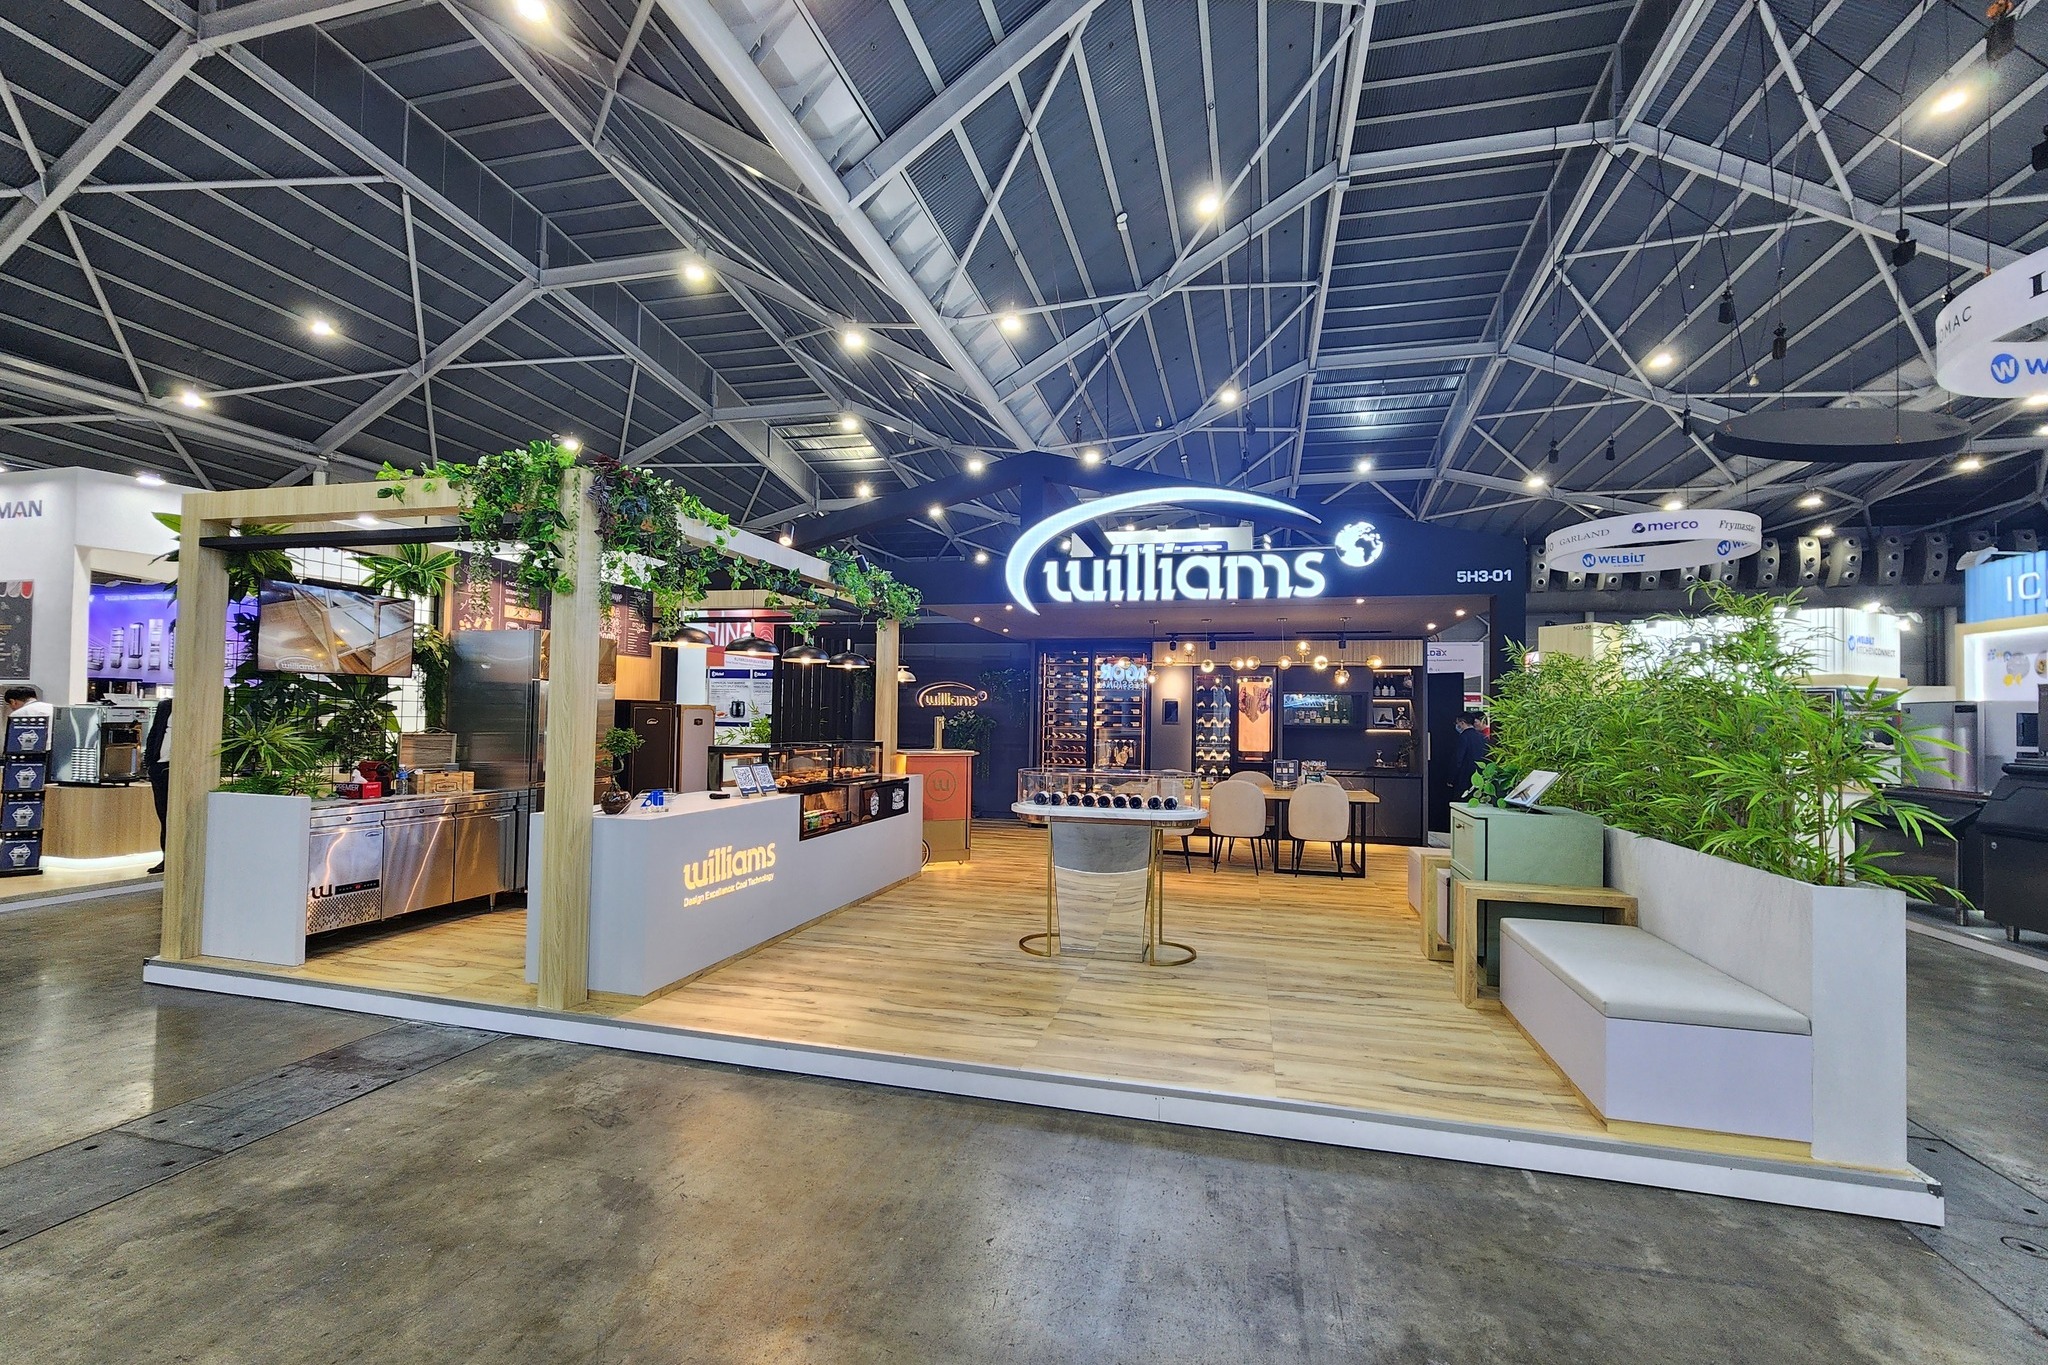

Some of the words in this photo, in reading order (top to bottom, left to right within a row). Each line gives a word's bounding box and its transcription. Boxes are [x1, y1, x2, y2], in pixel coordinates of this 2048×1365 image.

[1648, 520, 1699, 532] merco
[1559, 529, 1610, 546] GARLAND
[1043, 543, 1326, 602] williams
[1457, 569, 1512, 582] 5H3-01
[925, 692, 979, 707] williams
[336, 783, 359, 792] PREMIER
[683, 842, 776, 890] williams
[683, 894, 705, 908] Design
[735, 880, 748, 891] Cool
[748, 872, 775, 887] Technology
